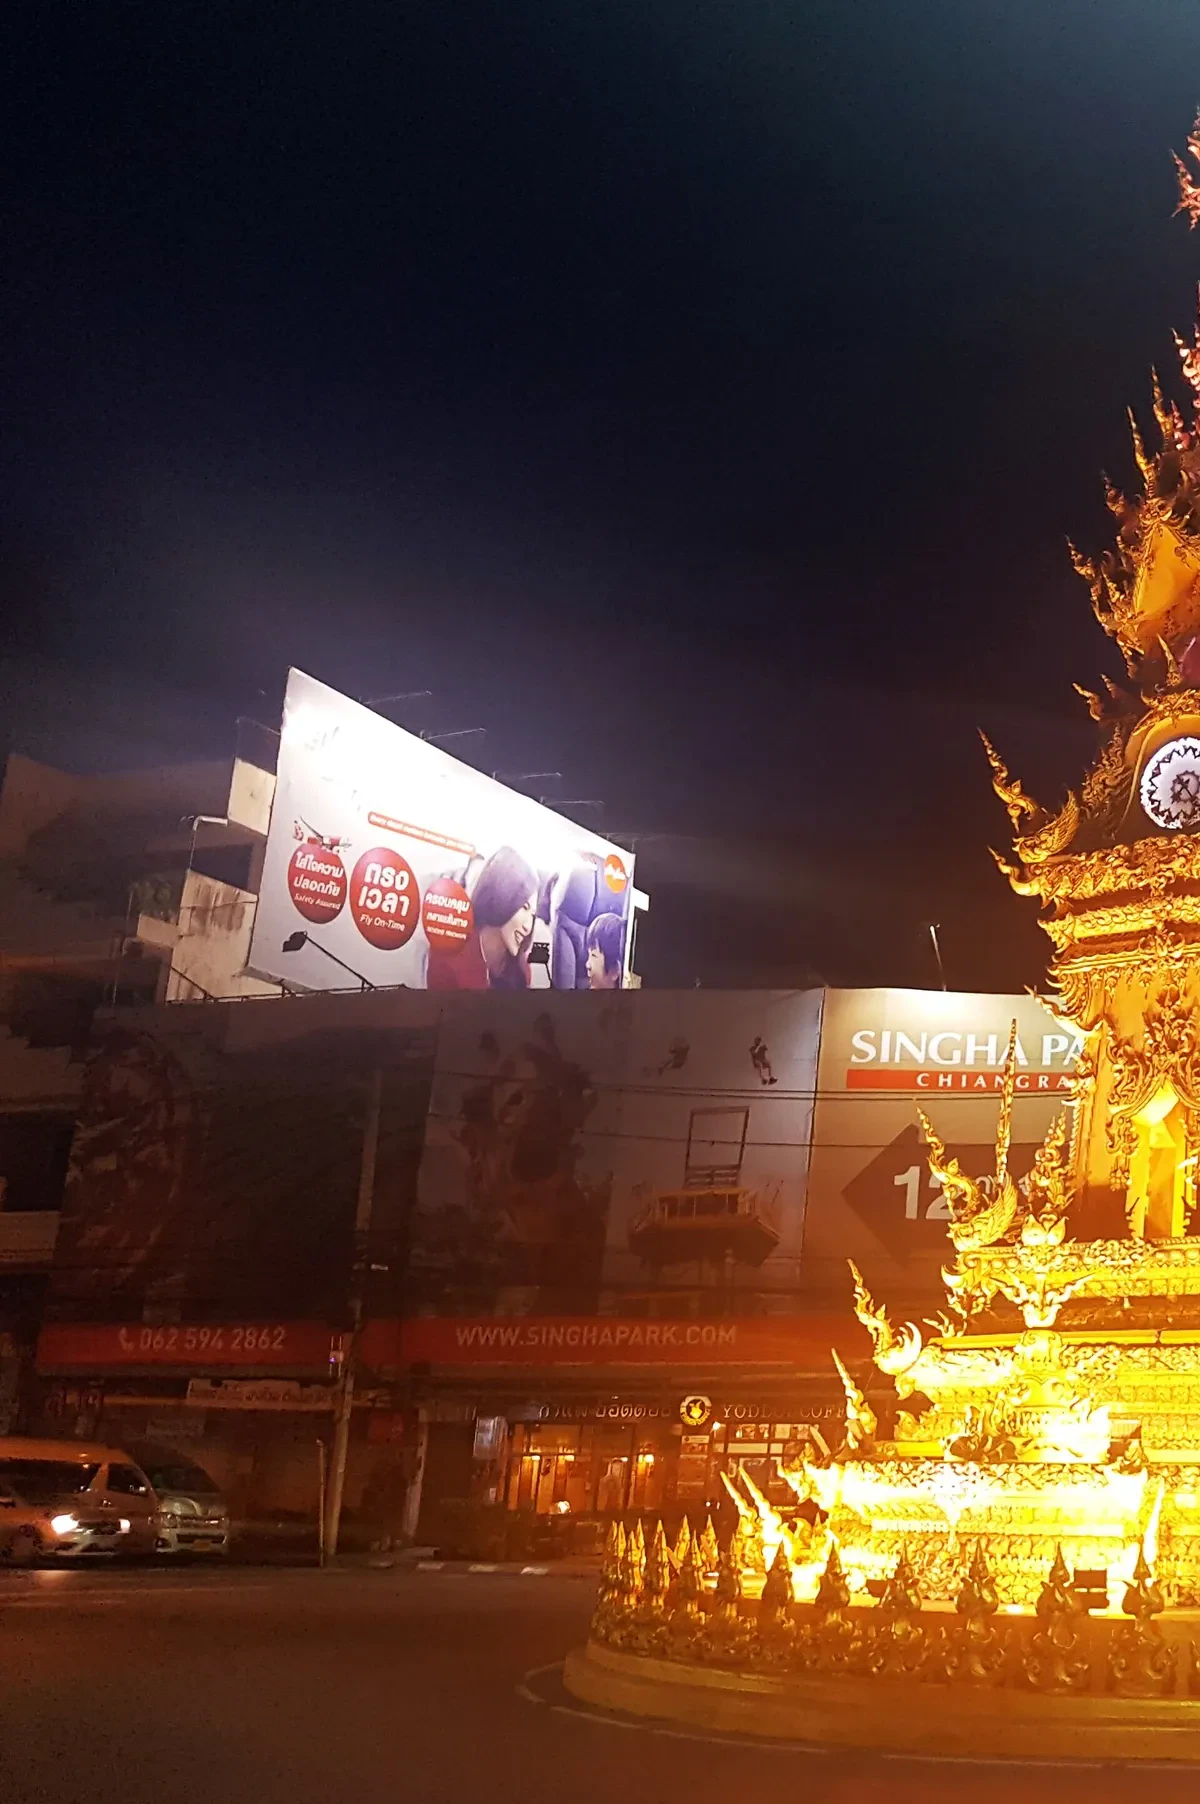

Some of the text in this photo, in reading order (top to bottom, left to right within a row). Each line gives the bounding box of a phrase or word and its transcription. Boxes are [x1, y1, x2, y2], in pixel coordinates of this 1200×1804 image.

[294, 874, 341, 897] ปลอดภัย
[294, 893, 316, 905] Safety
[358, 885, 410, 917] เวลา
[360, 913, 406, 932] Fly On-Time
[850, 1029, 1083, 1067] SINGHA PA
[916, 1072, 1068, 1089] CHIANGRA
[140, 1324, 288, 1351] 062 594 2862
[456, 1324, 737, 1347] WWW.SINGHAPARK.COM
